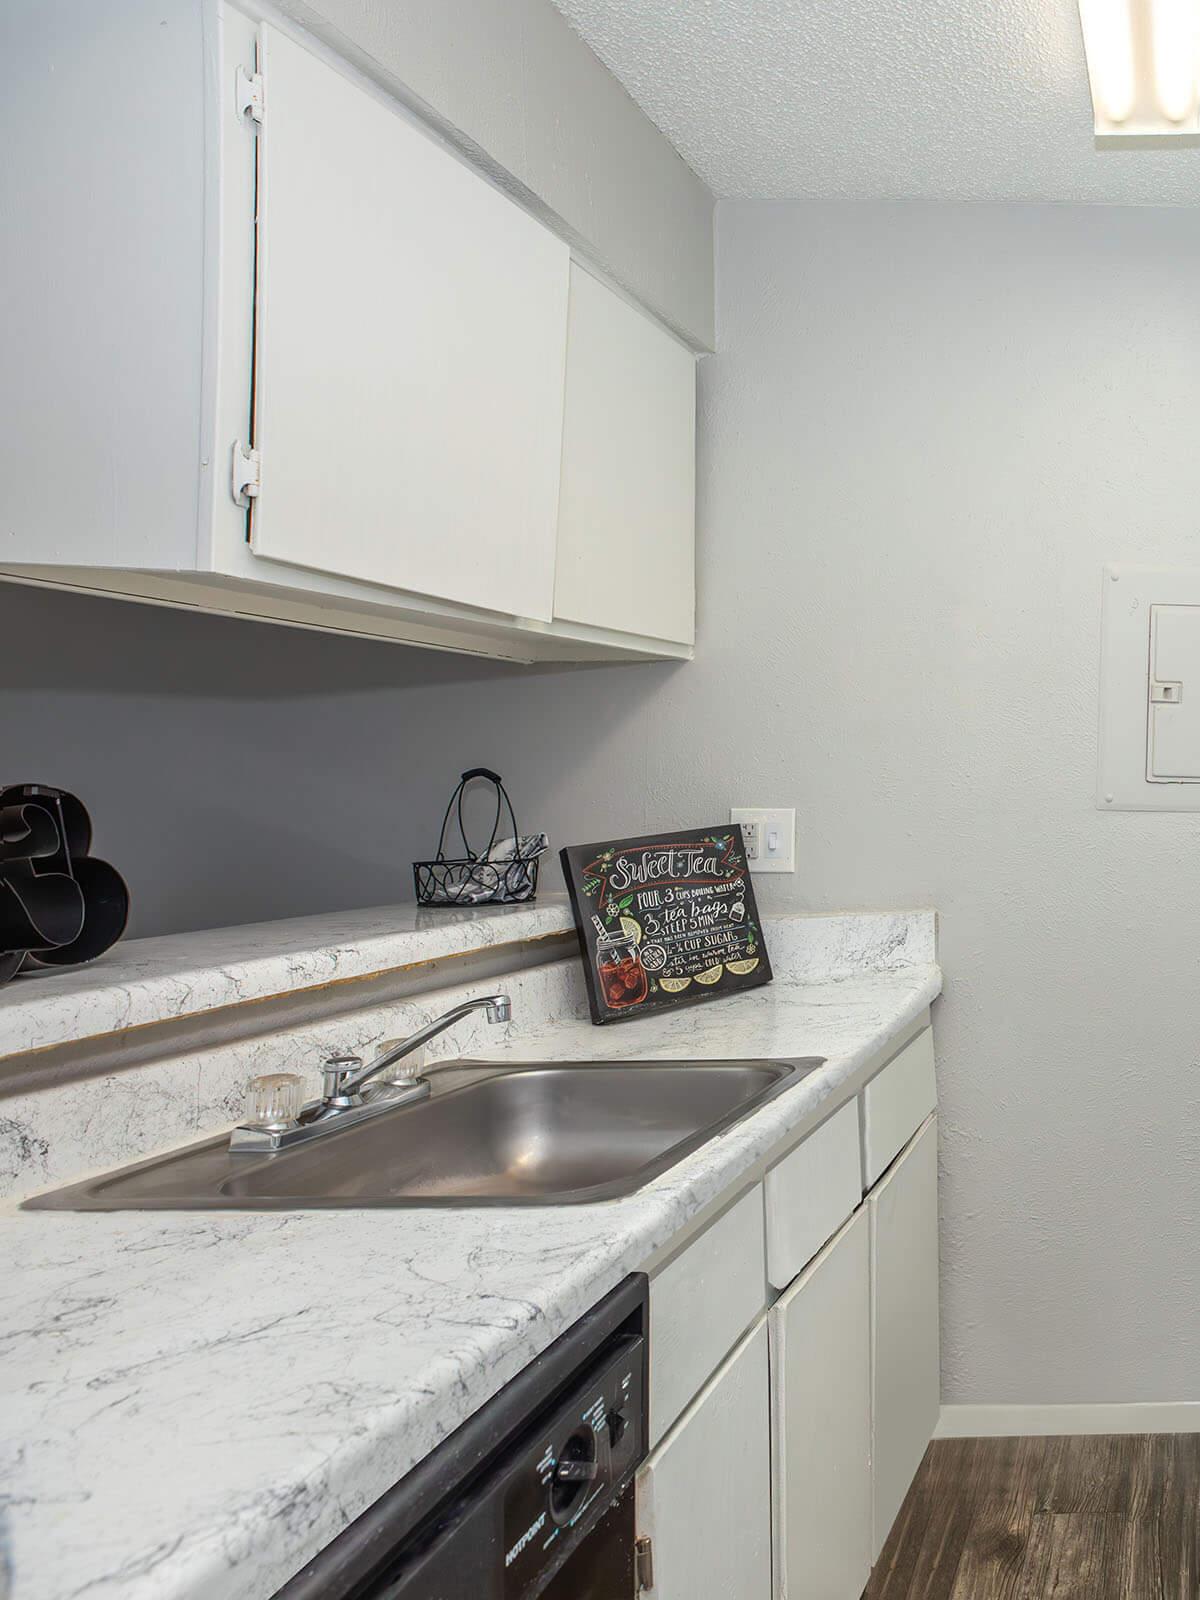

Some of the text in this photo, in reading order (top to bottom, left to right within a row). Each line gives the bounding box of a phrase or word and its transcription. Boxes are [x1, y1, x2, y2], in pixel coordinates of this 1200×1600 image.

[610, 848, 723, 889] Sweet Tea
[665, 888, 674, 902] 3
[644, 901, 728, 935] 3 tea bags
[660, 914, 714, 936] STEEP 5 MIN
[684, 939, 703, 951] CUP
[704, 931, 738, 947] SUGAR
[675, 966, 683, 975] 5
[505, 1512, 546, 1567] HOTPOINT
